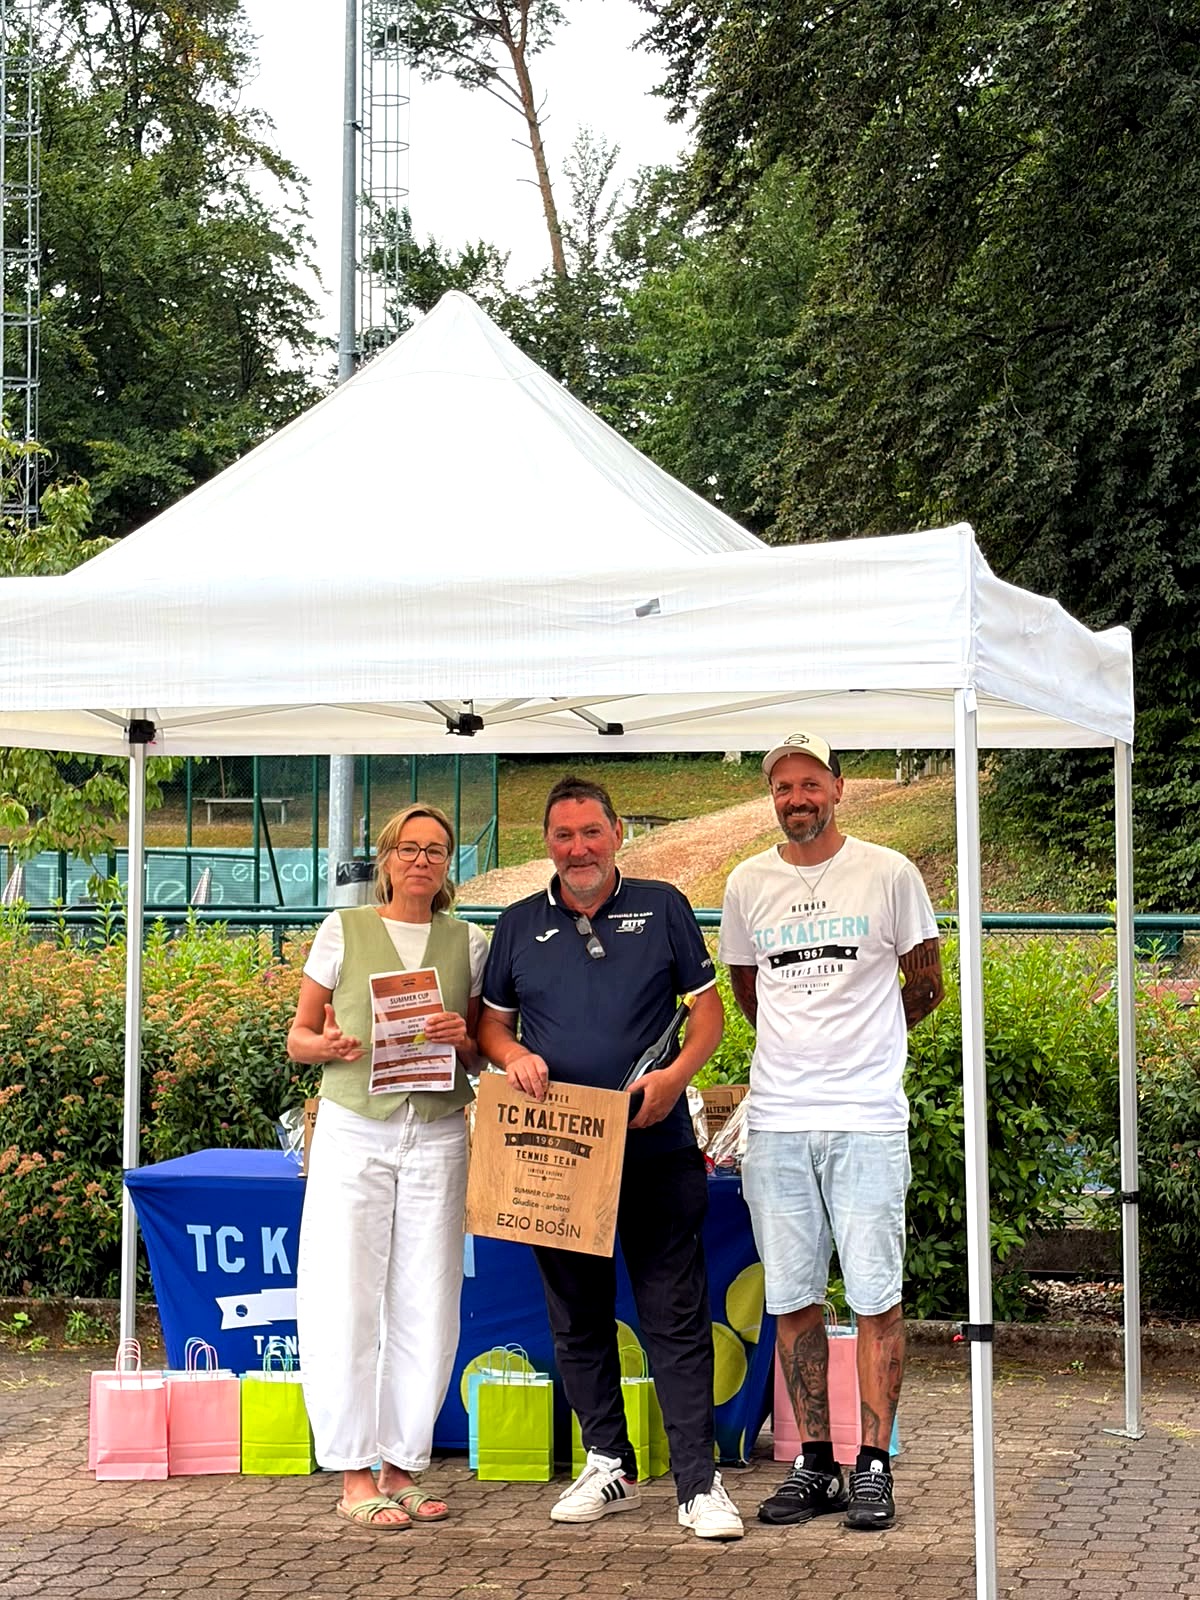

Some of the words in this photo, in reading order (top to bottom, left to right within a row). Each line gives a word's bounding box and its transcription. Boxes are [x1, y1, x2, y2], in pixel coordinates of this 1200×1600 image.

[791, 900, 827, 913] MEMBER
[754, 927, 776, 949] TC
[780, 915, 869, 945] KALTERN
[798, 948, 825, 960] 1967
[781, 967, 811, 979] TENNIS
[817, 963, 843, 974] TEAM
[390, 994, 417, 1005] SUMMER
[417, 992, 429, 1000] CUP
[705, 1106, 731, 1114] ALTERN
[497, 1103, 519, 1125] TC
[524, 1107, 605, 1138] KALTERN
[536, 1136, 561, 1147] 1967
[516, 1149, 549, 1162] TENNIS
[554, 1155, 577, 1167] TEAM
[514, 1186, 541, 1196] SUMMER
[542, 1191, 555, 1199] CUP
[512, 1197, 539, 1208] Giudice
[545, 1203, 570, 1214] arbitro
[497, 1212, 531, 1230] EZIO
[186, 1224, 246, 1274] TC
